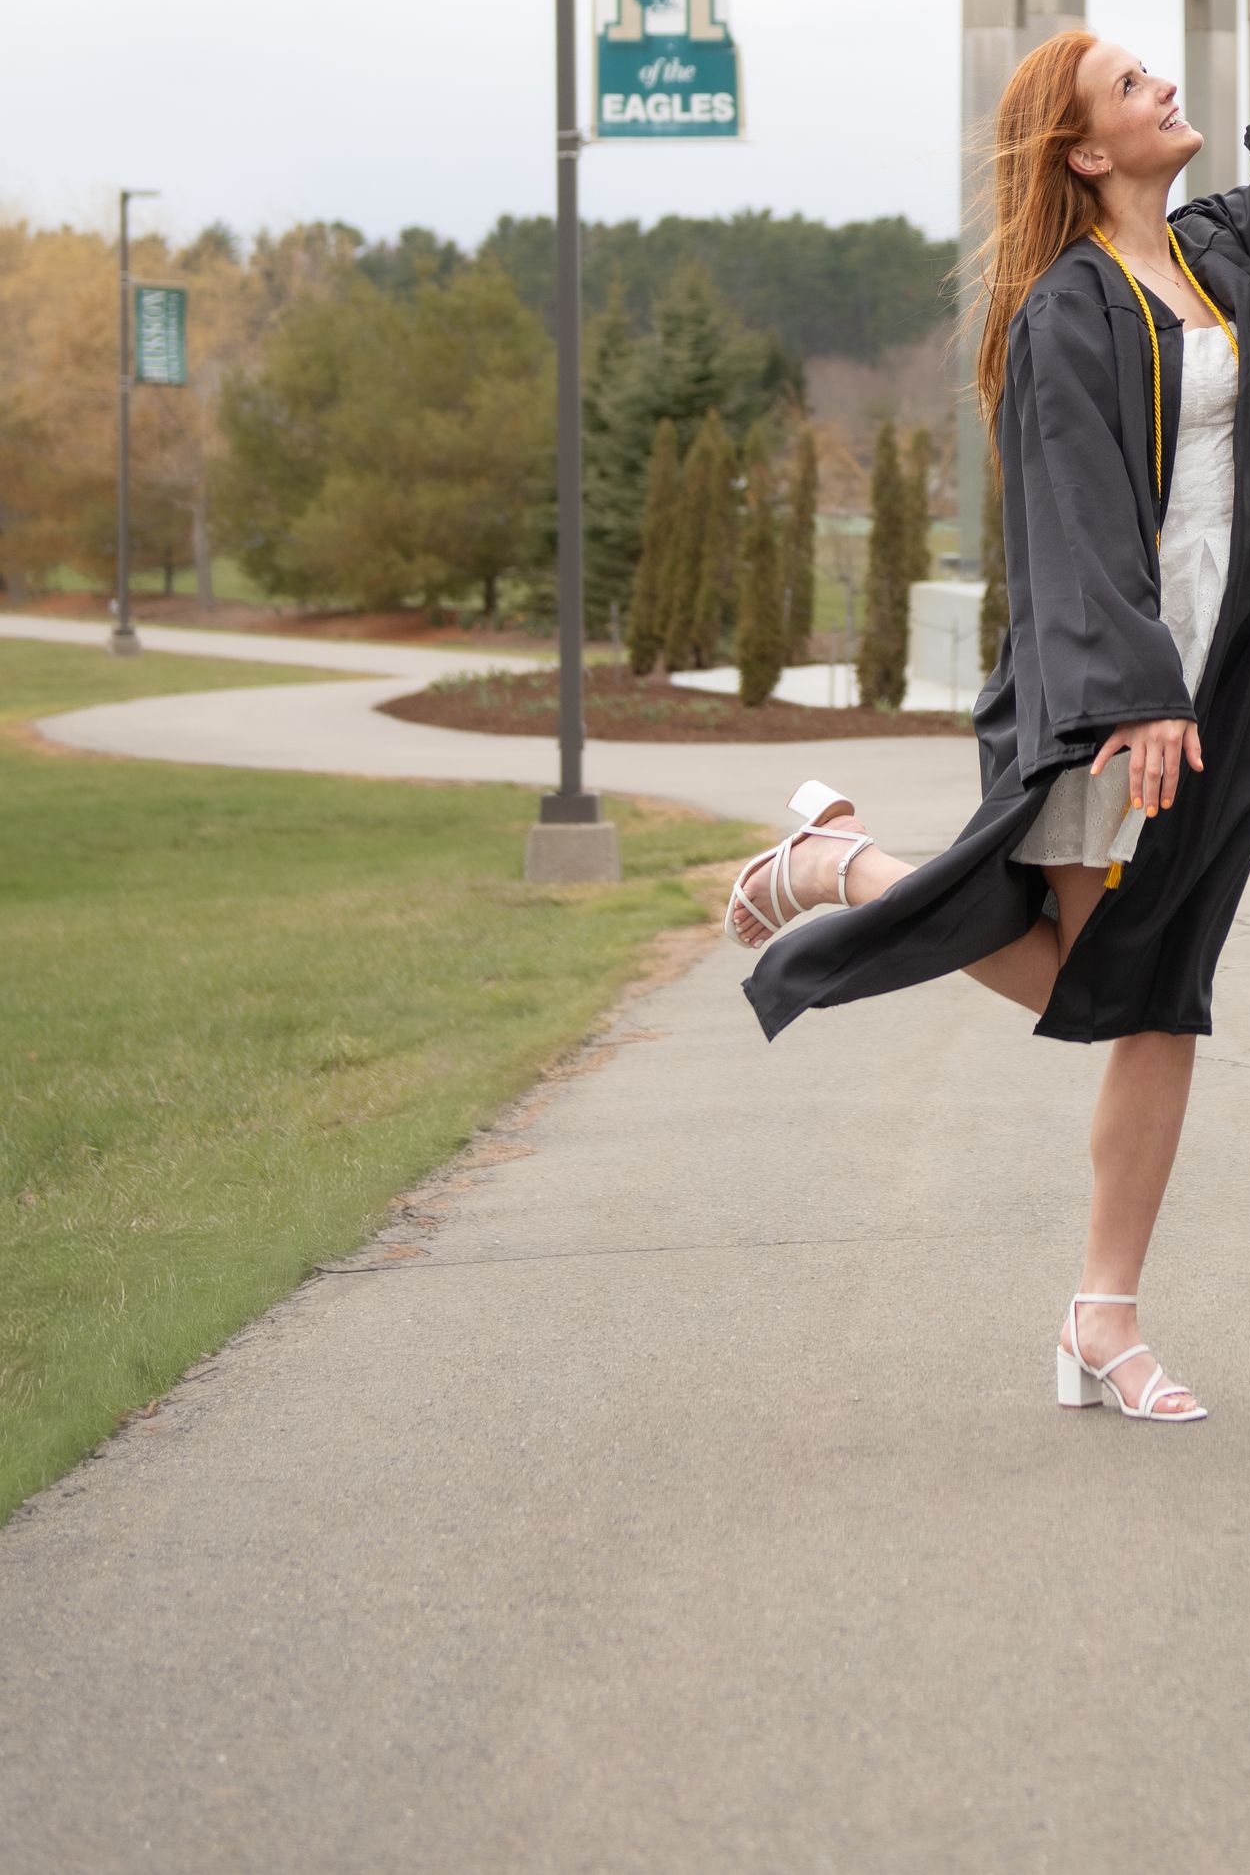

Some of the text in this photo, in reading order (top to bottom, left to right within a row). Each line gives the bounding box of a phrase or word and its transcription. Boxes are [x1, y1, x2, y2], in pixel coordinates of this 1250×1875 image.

[638, 57, 696, 89] of the
[602, 92, 734, 122] EAGLES
